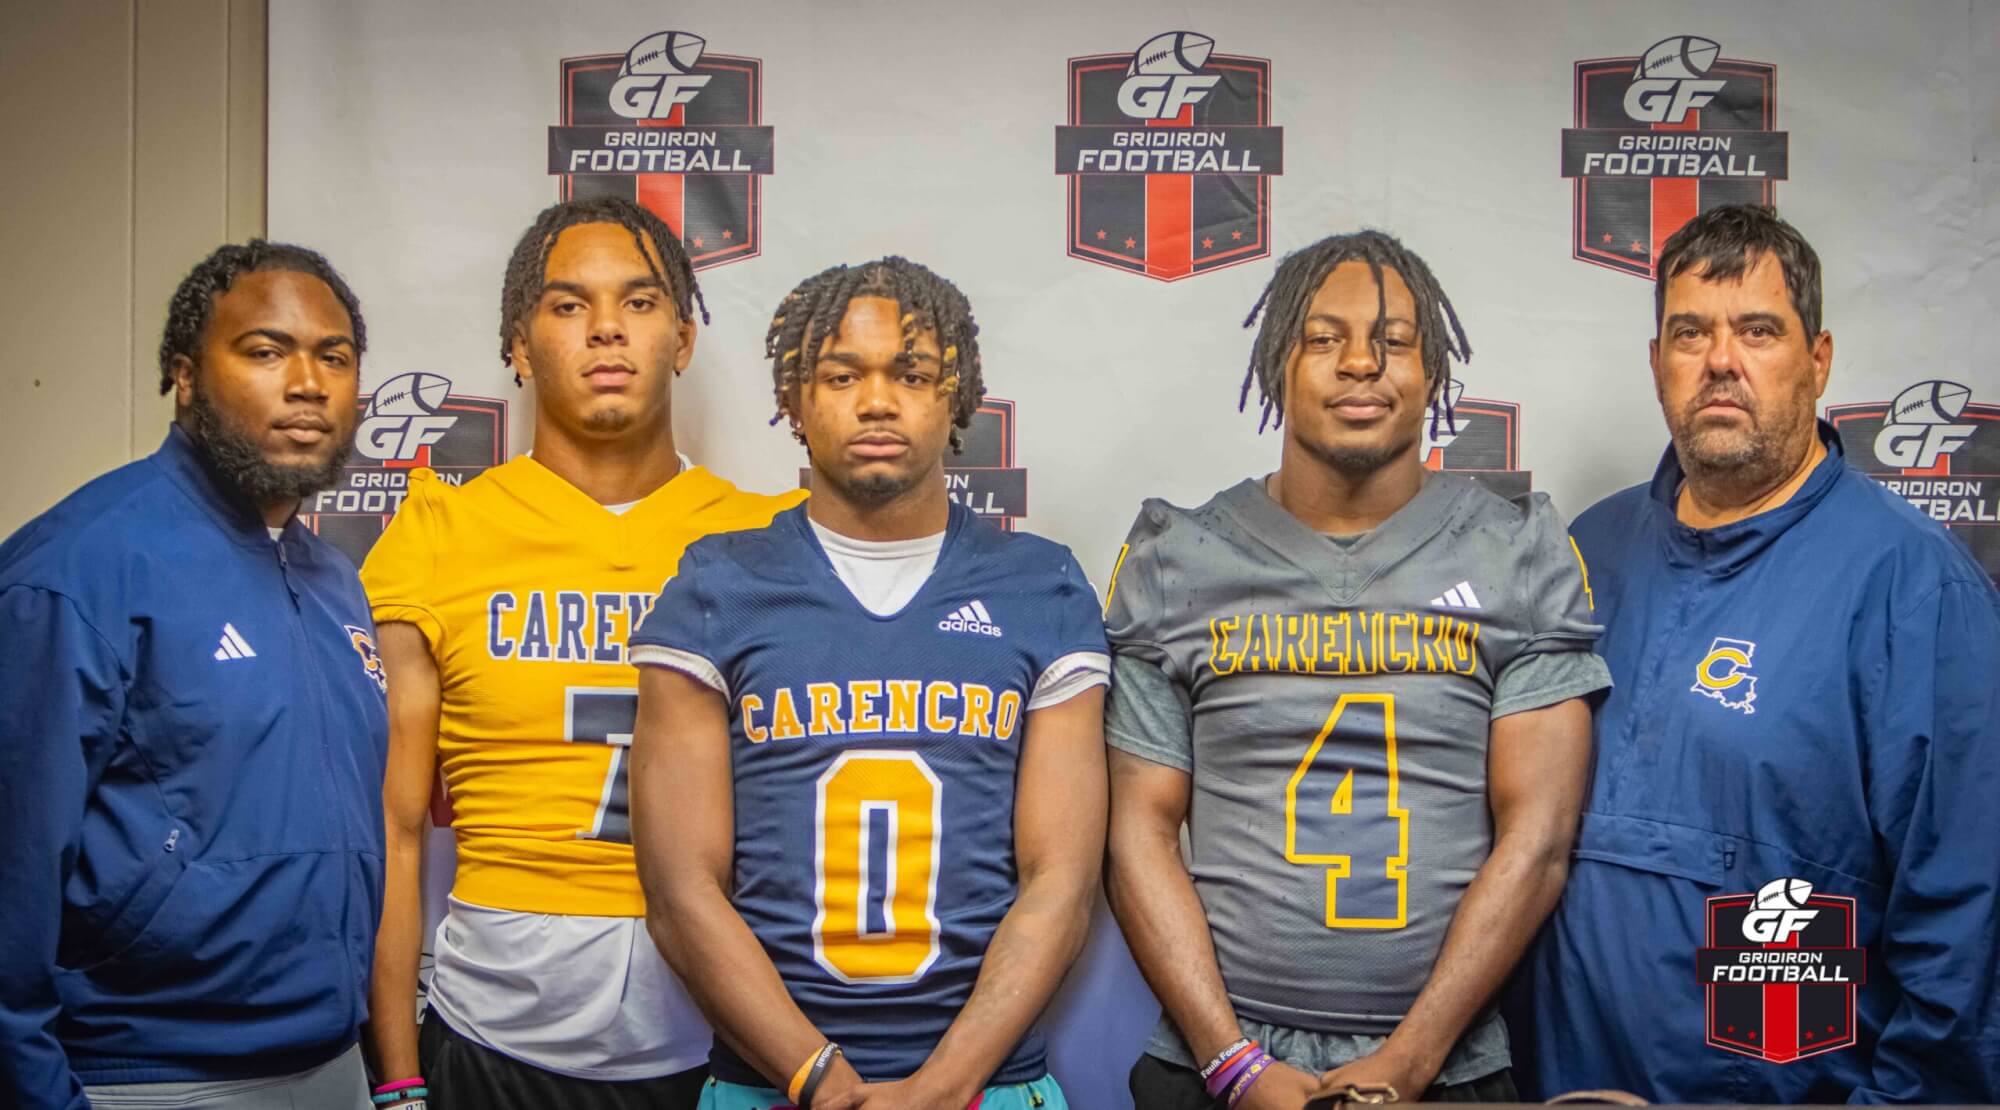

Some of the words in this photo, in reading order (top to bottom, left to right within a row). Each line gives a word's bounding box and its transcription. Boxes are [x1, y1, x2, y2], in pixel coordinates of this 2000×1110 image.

[609, 75, 712, 119] GF
[1117, 75, 1221, 119] GF
[1623, 79, 1727, 123] GF
[569, 149, 752, 173] FOOTBALL
[604, 131, 716, 148] GRIDIRON
[1076, 149, 1261, 173] FOOTBALL
[1112, 131, 1226, 148] GRIDIRON
[1619, 135, 1732, 152] GRIDIRON
[1583, 153, 1766, 177] FOOTBALL
[355, 416, 458, 460] GF
[1874, 424, 1979, 468] GF
[938, 619, 1002, 637] adidas
[1208, 611, 1480, 676] CARENCRO
[740, 679, 1022, 743] CARENCRO
[1284, 693, 1409, 929] 4
[812, 749, 943, 985] 0
